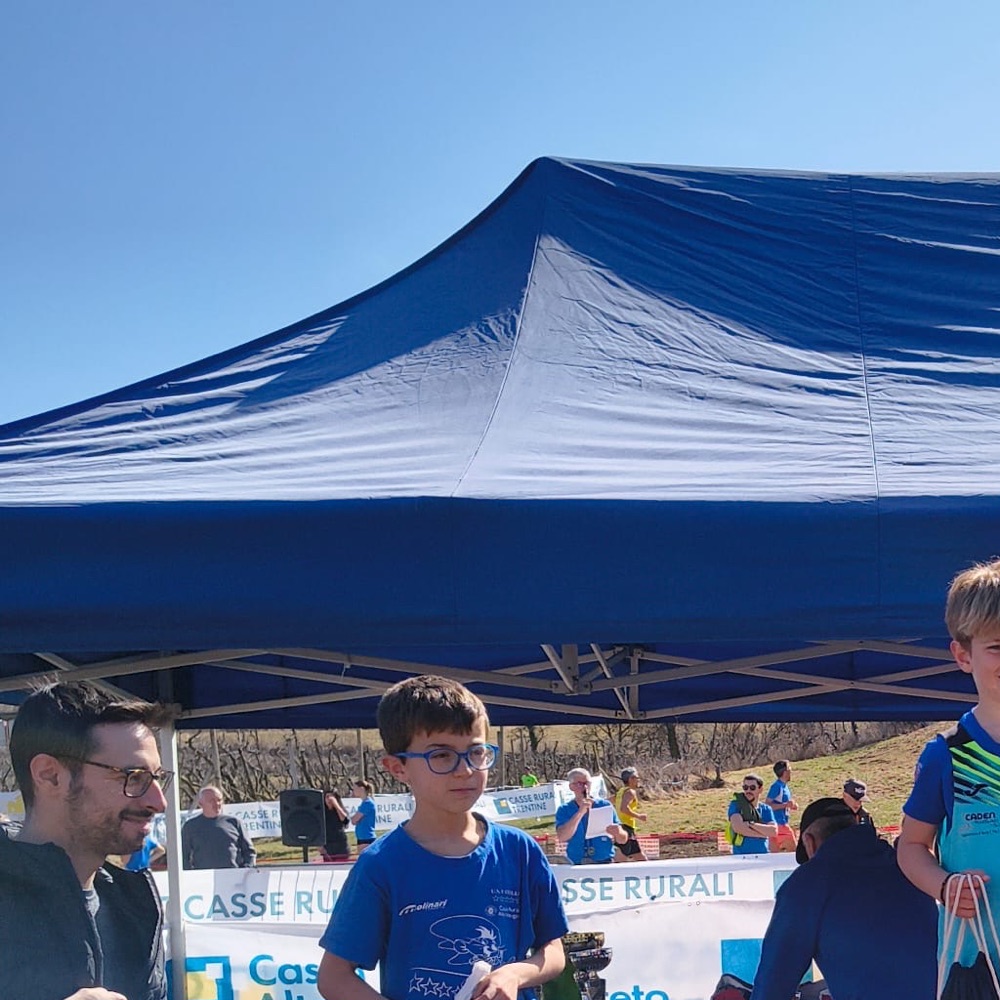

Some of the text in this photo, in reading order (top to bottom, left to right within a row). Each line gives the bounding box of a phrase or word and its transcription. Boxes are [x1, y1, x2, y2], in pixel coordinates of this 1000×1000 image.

[509, 792, 533, 804] CASSE
[511, 802, 547, 813] TRENTINE
[965, 812, 996, 821] CADEN
[625, 873, 734, 900] RURALI
[184, 891, 285, 920] CASSE
